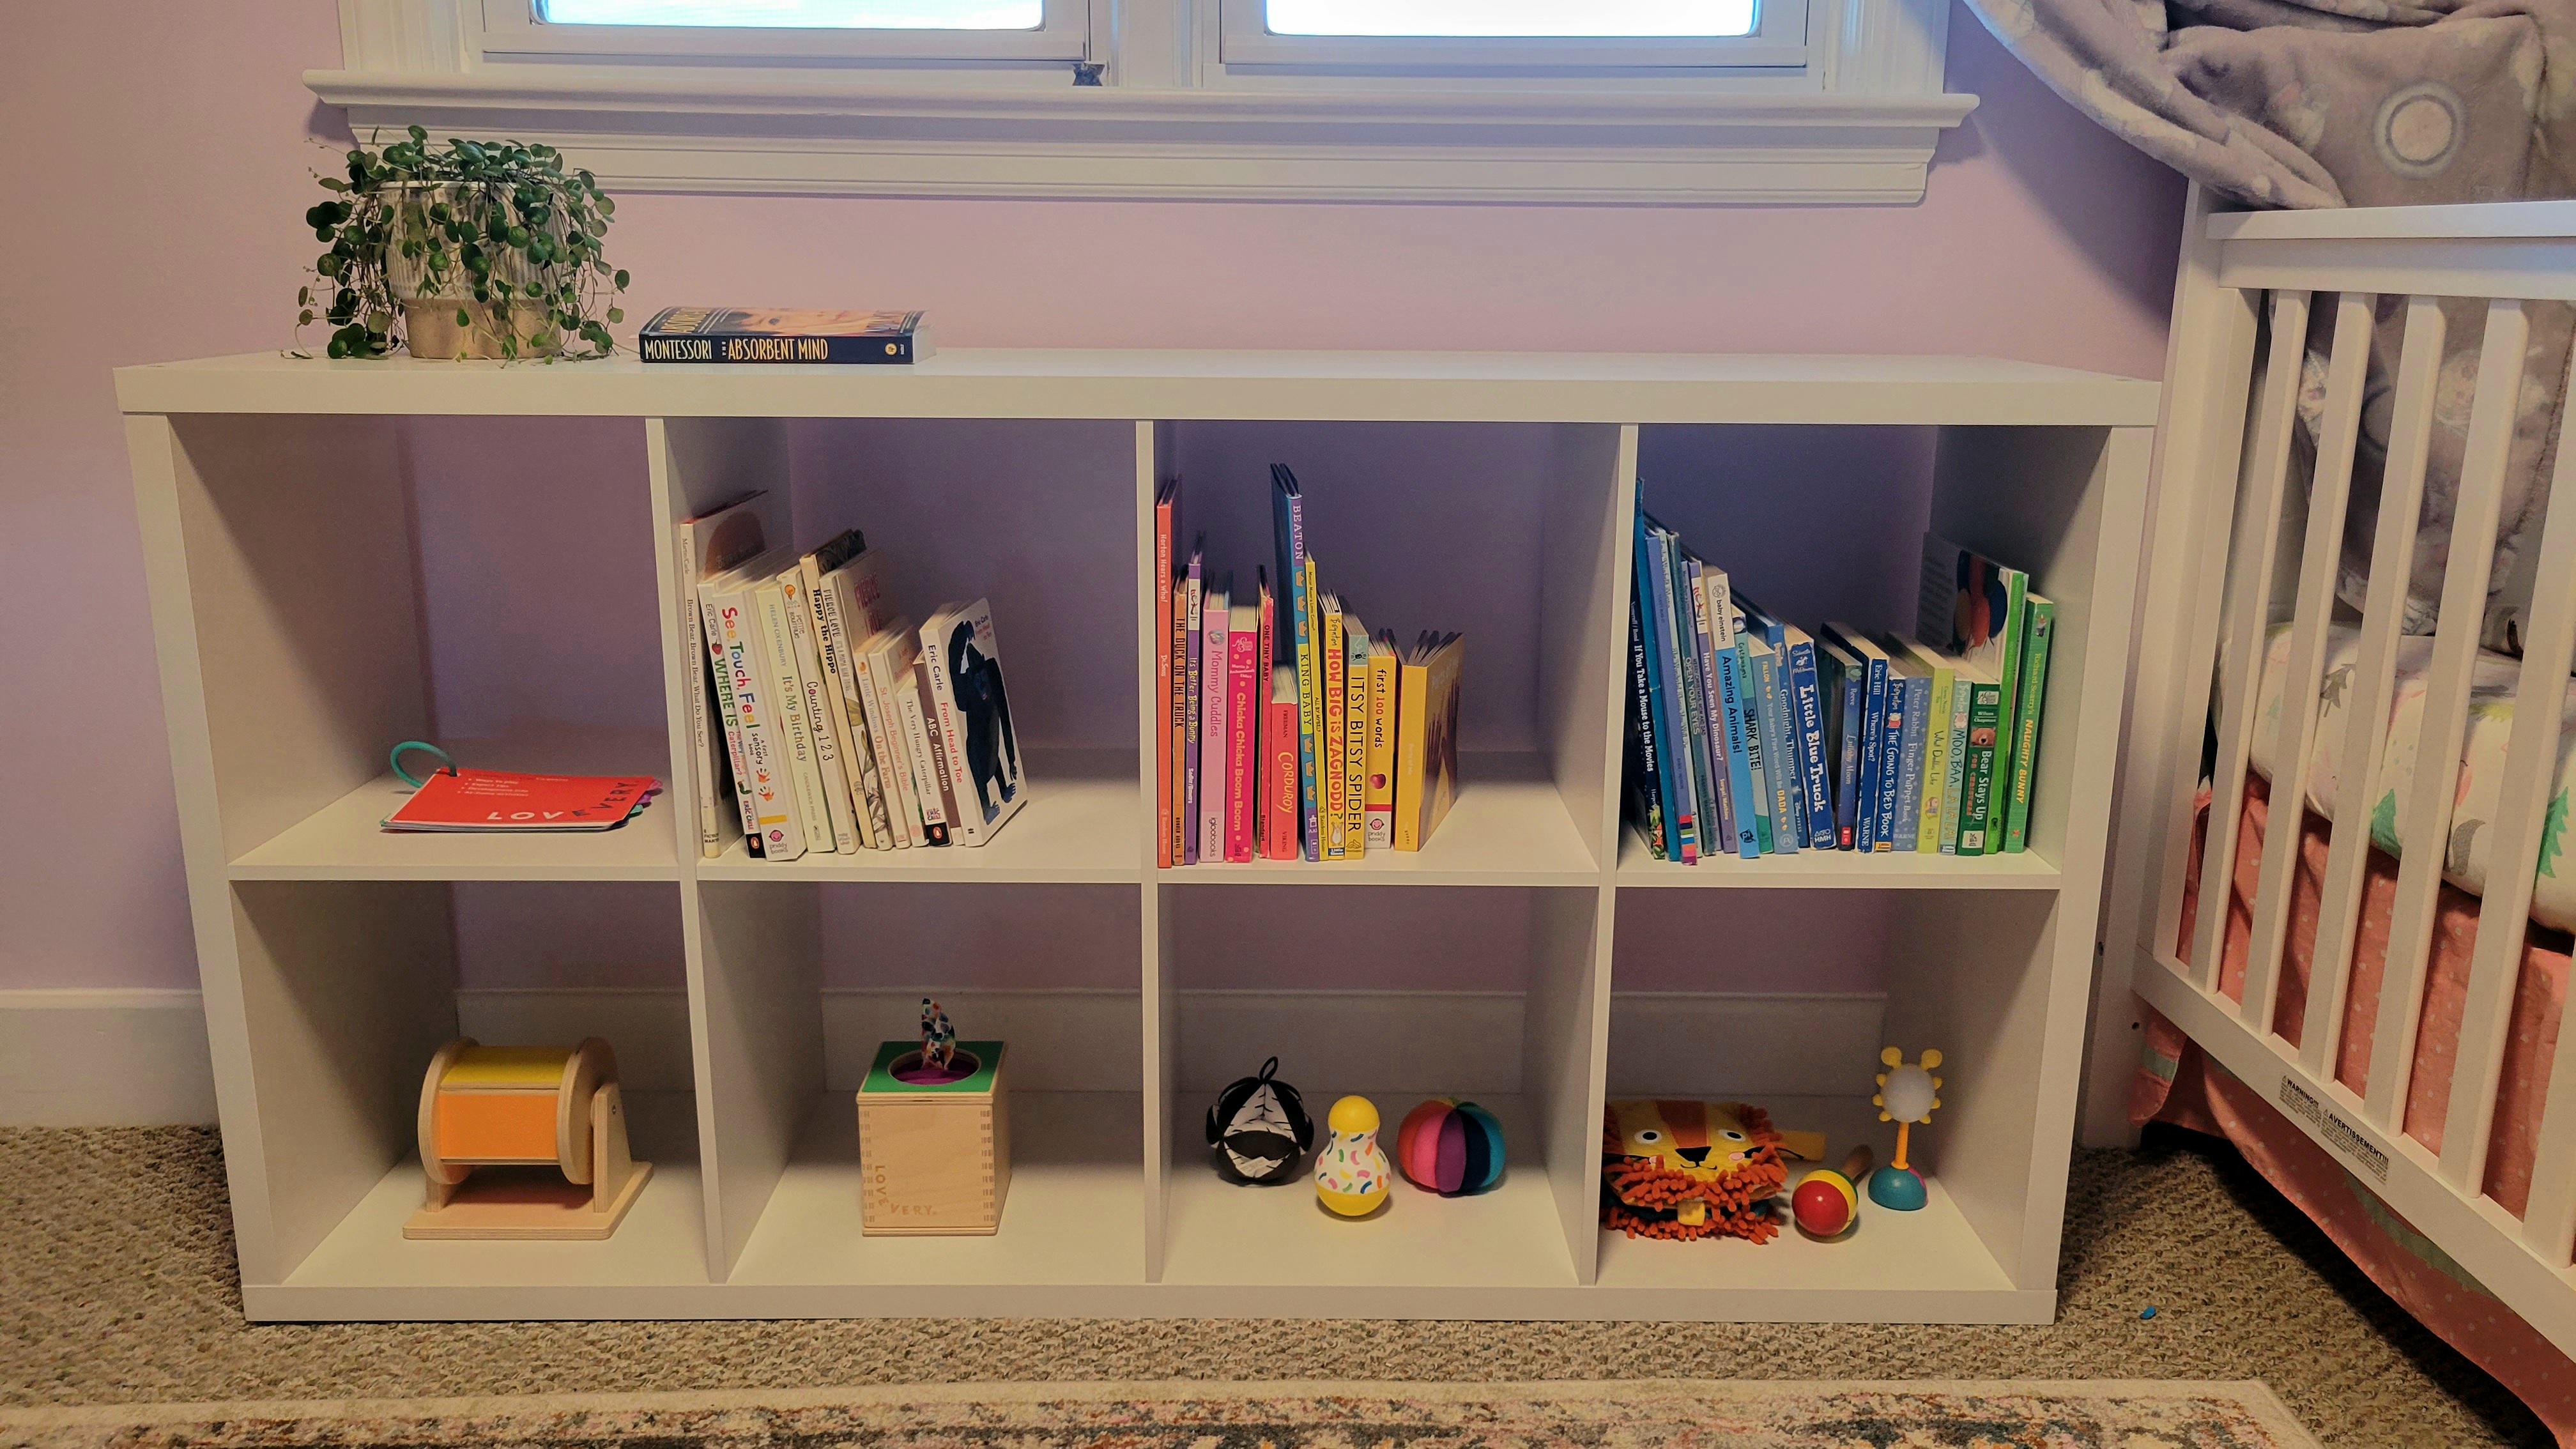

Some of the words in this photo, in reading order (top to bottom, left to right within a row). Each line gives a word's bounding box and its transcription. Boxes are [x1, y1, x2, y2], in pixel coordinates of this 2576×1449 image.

[645, 339, 712, 359] MONTESSORI
[728, 339, 793, 360] ABSORBENT
[799, 339, 829, 360] MIND
[1293, 505, 1304, 560] BEATON
[1160, 585, 1169, 602] Who!
[769, 604, 779, 627] HELEN
[774, 627, 787, 667] OXENBURY
[813, 589, 825, 622] Happy
[820, 625, 829, 641] the
[825, 644, 836, 674] Hippo
[1176, 618, 1186, 632] THE
[1329, 618, 1341, 646] Boynton
[1717, 615, 1727, 642] einstein
[928, 645, 937, 663] Eric
[1175, 636, 1186, 660] DUCK
[1636, 653, 1644, 668] You
[1738, 642, 1747, 679] Costamagna
[709, 618, 717, 636] Carle
[714, 658, 735, 710] WHERE
[725, 714, 739, 727] IS
[730, 641, 751, 691] Touch,
[933, 666, 944, 691] Carle
[1174, 665, 1185, 676] ON
[1208, 650, 1223, 693] Mommy
[1300, 654, 1310, 687] KING
[1328, 648, 1342, 682] HOW
[1637, 668, 1646, 688] Take
[1685, 657, 1694, 682] OPEN
[1874, 664, 1883, 680] Eric
[2031, 652, 2042, 684] Richard
[782, 676, 794, 693] It's
[862, 677, 871, 697] Little
[1174, 682, 1184, 696] THE
[1188, 670, 1198, 693] Better
[1376, 669, 1387, 693] first
[1705, 674, 1713, 688] You
[1722, 656, 1736, 704] Amazing
[1873, 681, 1882, 695] Hill
[786, 695, 798, 710] My
[806, 681, 823, 733] Counting
[1187, 694, 1197, 715] Being
[1302, 692, 1312, 726] BABY
[1328, 687, 1342, 717] BIG
[1351, 677, 1365, 714] ITSY
[1376, 697, 1385, 715] 100
[1639, 696, 1648, 721] Mouse
[1688, 686, 1696, 709] YOUR
[1799, 684, 1816, 728] Little
[1890, 682, 1904, 710] Boynton
[1913, 688, 1922, 710] Peter
[2027, 684, 2037, 715] Scarry's
[695, 705, 702, 714] Do
[739, 693, 760, 729] Feel
[866, 699, 878, 733] Windows
[940, 702, 951, 727] From
[1174, 703, 1184, 728] TRUCK
[1210, 696, 1222, 737] Cuddles
[1236, 692, 1246, 729] Chicka
[1692, 711, 1700, 735] EYES
[1710, 710, 1719, 722] My
[1188, 721, 1198, 744] Bunny
[1374, 717, 1384, 748] words
[1642, 721, 1650, 730] to
[1643, 730, 1652, 744] the
[1728, 707, 1743, 753] Animals!
[1744, 708, 1758, 742] SHARK
[1761, 661, 1770, 683] FALLON
[1777, 790, 1787, 813] DADA
[1780, 689, 1791, 739] Goodnight,
[1786, 739, 1797, 780] Thumper
[1869, 711, 1879, 740] Where's
[1911, 710, 1920, 737] Rabbit
[751, 733, 763, 765] sensory
[790, 713, 806, 762] Birthday
[874, 735, 884, 748] On
[882, 701, 894, 729] Joseph
[889, 730, 904, 770] Beginner's
[898, 771, 908, 792] Bible
[946, 730, 958, 754] Head
[1236, 730, 1246, 767] Chicka
[1349, 721, 1363, 767] BITSY
[1712, 723, 1724, 761] Dinosaur?
[1806, 730, 1821, 763] Blue
[1845, 734, 1857, 762] Lullaby
[1887, 730, 1900, 747] THE
[1950, 730, 1965, 758] MOO,
[2020, 719, 2034, 767] NAUGHTY
[728, 731, 743, 776] Caterpillar?
[878, 752, 887, 765] the
[913, 733, 923, 759] Hungry
[919, 760, 931, 795] Caterpillar
[926, 717, 938, 737] ABC
[933, 742, 949, 792] Affirmation
[951, 755, 959, 766] to
[1644, 745, 1654, 772] Movies
[1748, 745, 1762, 771] BITE!
[1867, 742, 1877, 763] Spot?
[1886, 747, 1899, 776] GOING
[1906, 742, 1918, 772] Finger
[1980, 750, 1993, 774] Bear
[954, 766, 963, 784] Toe
[1234, 769, 1244, 799] Boom
[1276, 751, 1295, 813] CORDUROY
[1809, 763, 1827, 812] Truck
[1845, 763, 1855, 785] Moon
[1884, 778, 1894, 788] TO
[2016, 769, 2028, 804] BUNNY
[1348, 774, 1363, 832] SPIDER
[1883, 788, 1895, 810] BED
[1947, 788, 1959, 804] LA
[1975, 777, 1989, 803] Stays
[1234, 801, 1243, 831] Boom
[1880, 811, 1892, 838] BOOK
[1945, 807, 1959, 819] LA
[1974, 804, 1986, 820] Up
[1208, 817, 1218, 857] igloobooks
[1862, 816, 1871, 847] WARNE
